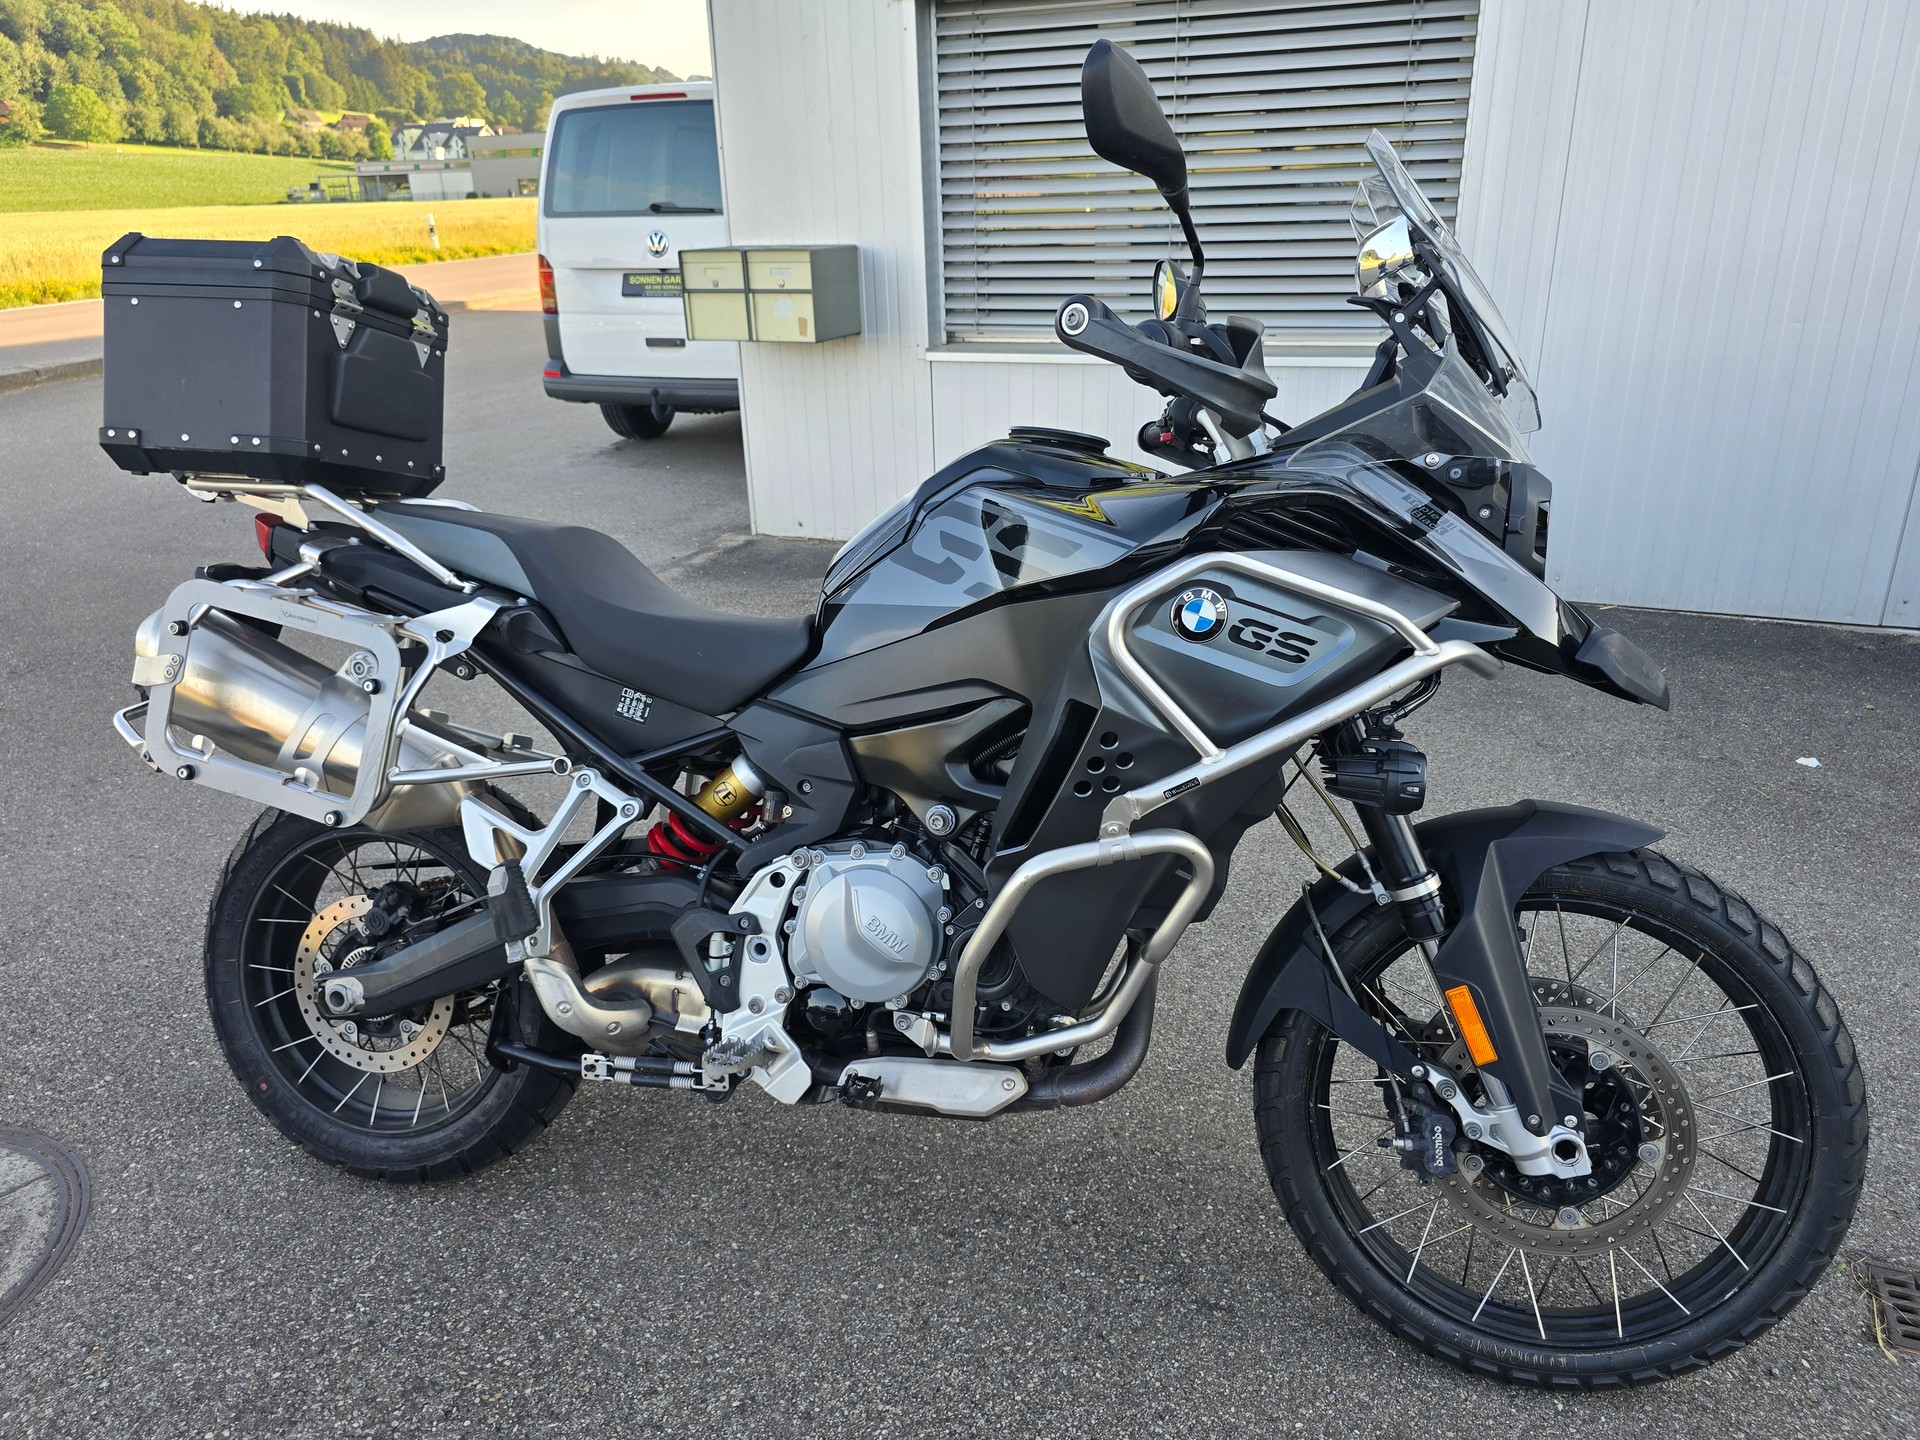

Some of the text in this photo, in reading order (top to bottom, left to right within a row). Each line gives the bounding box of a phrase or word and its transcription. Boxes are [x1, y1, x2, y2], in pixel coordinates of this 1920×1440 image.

[628, 275, 662, 285] SONNEN
[1183, 589, 1227, 613] BMW
[1228, 618, 1319, 664] GS
[865, 914, 910, 954] BMW
[1432, 1125, 1444, 1167] brembo
